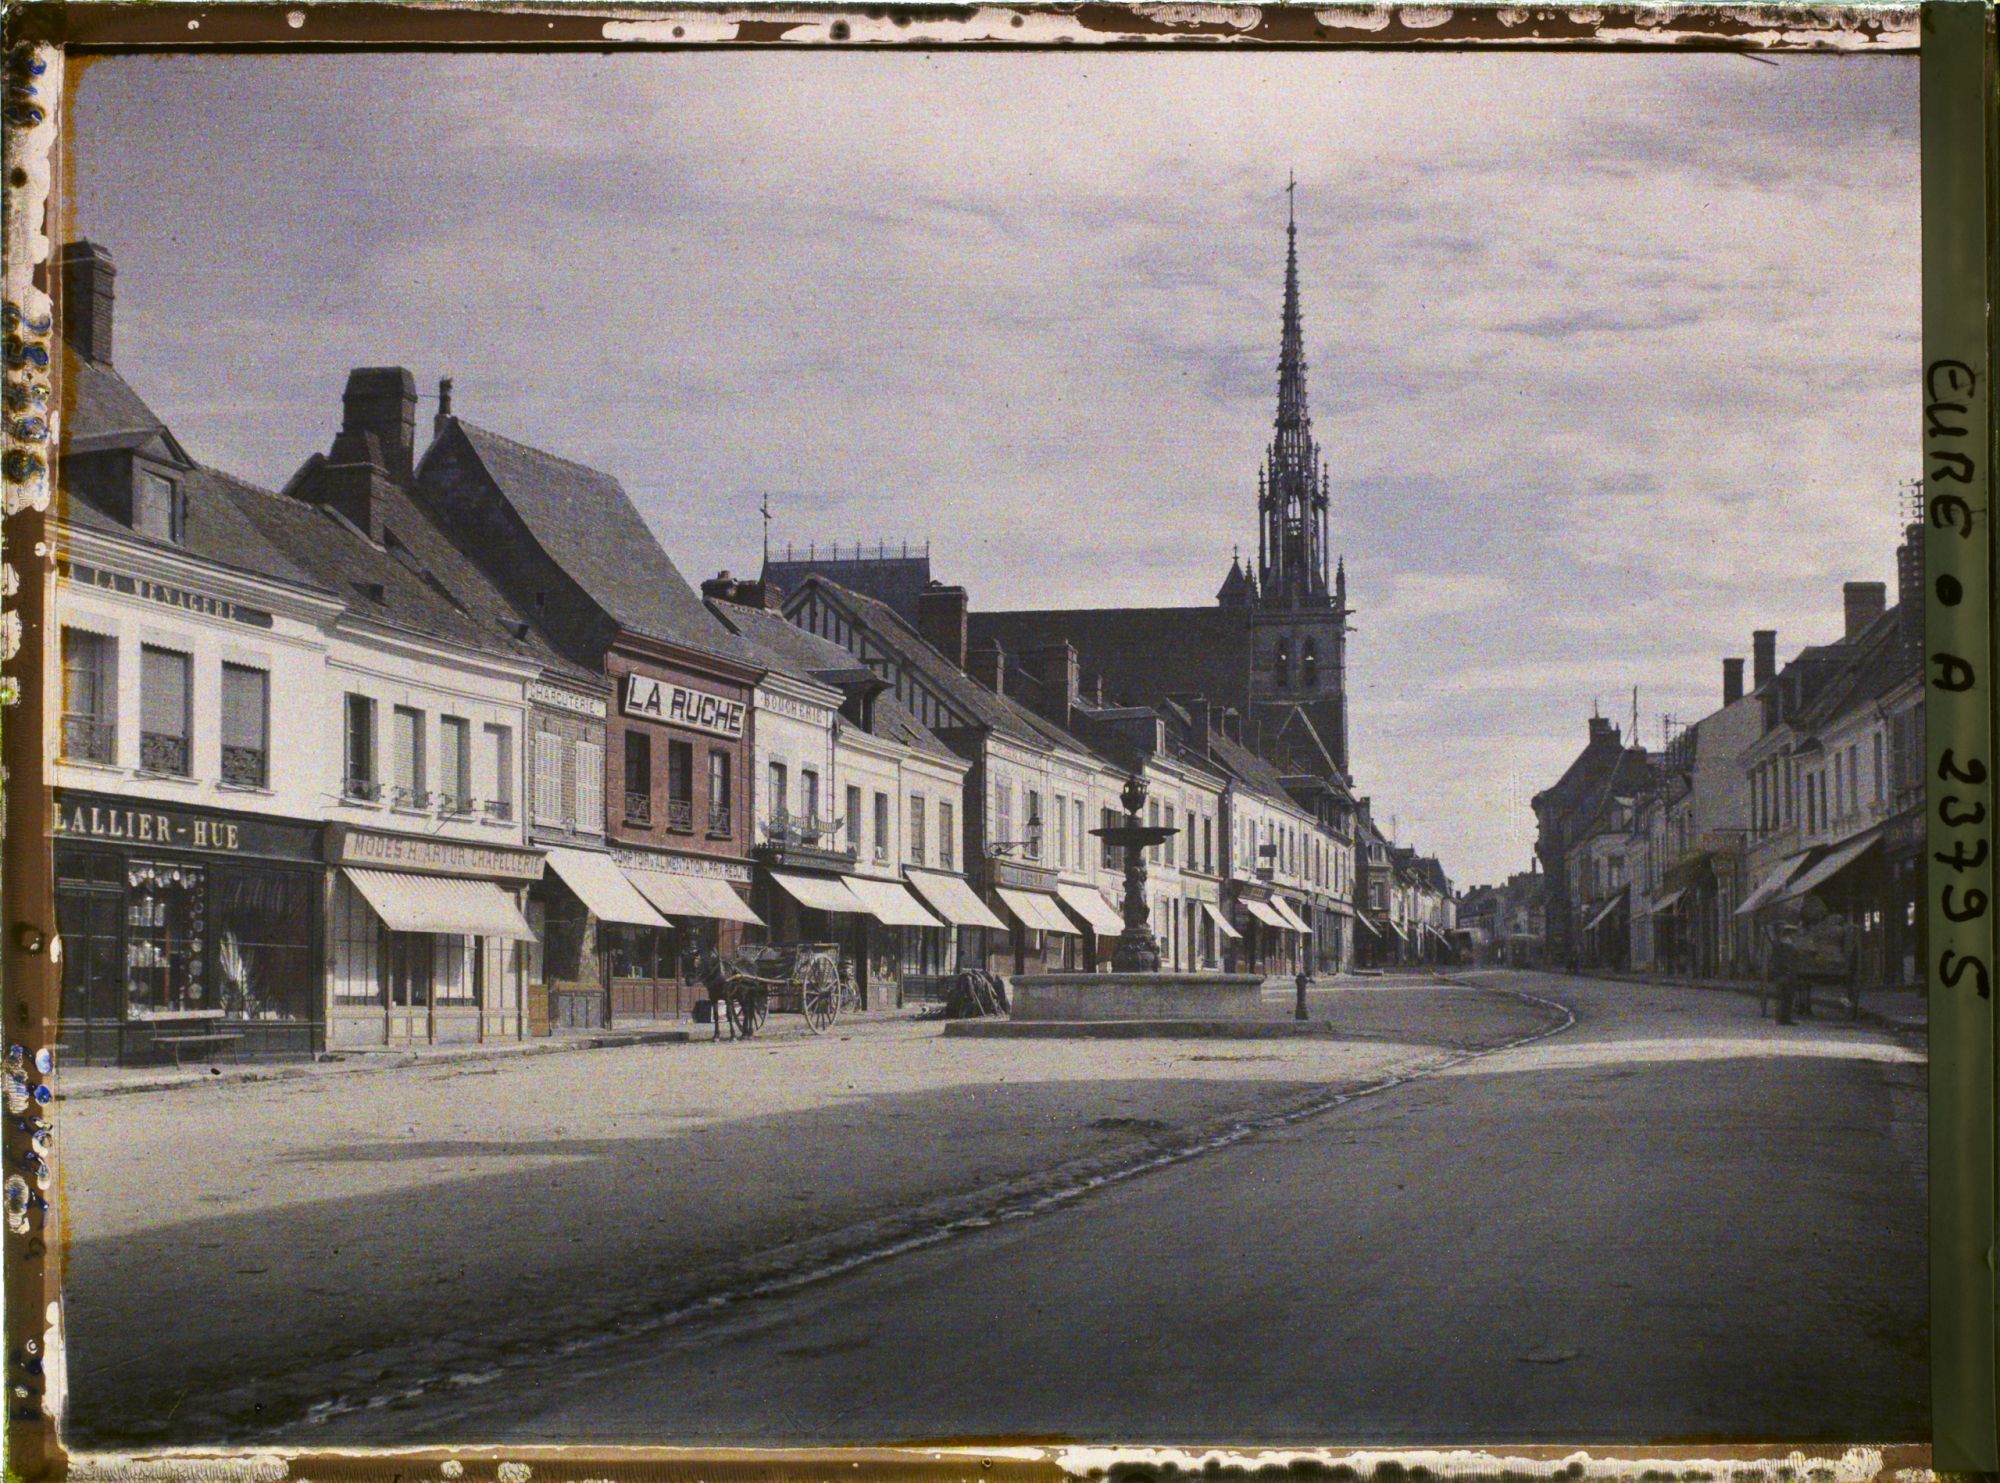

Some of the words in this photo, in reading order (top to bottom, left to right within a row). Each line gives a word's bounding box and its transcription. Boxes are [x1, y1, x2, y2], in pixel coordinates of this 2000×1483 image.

[1931, 652, 1976, 692] A
[628, 676, 662, 716] LA
[671, 687, 745, 733] RUCHE
[764, 692, 823, 723] BOUCHERIE
[354, 833, 402, 860] MODES
[472, 848, 542, 875] CHAPELLERIE
